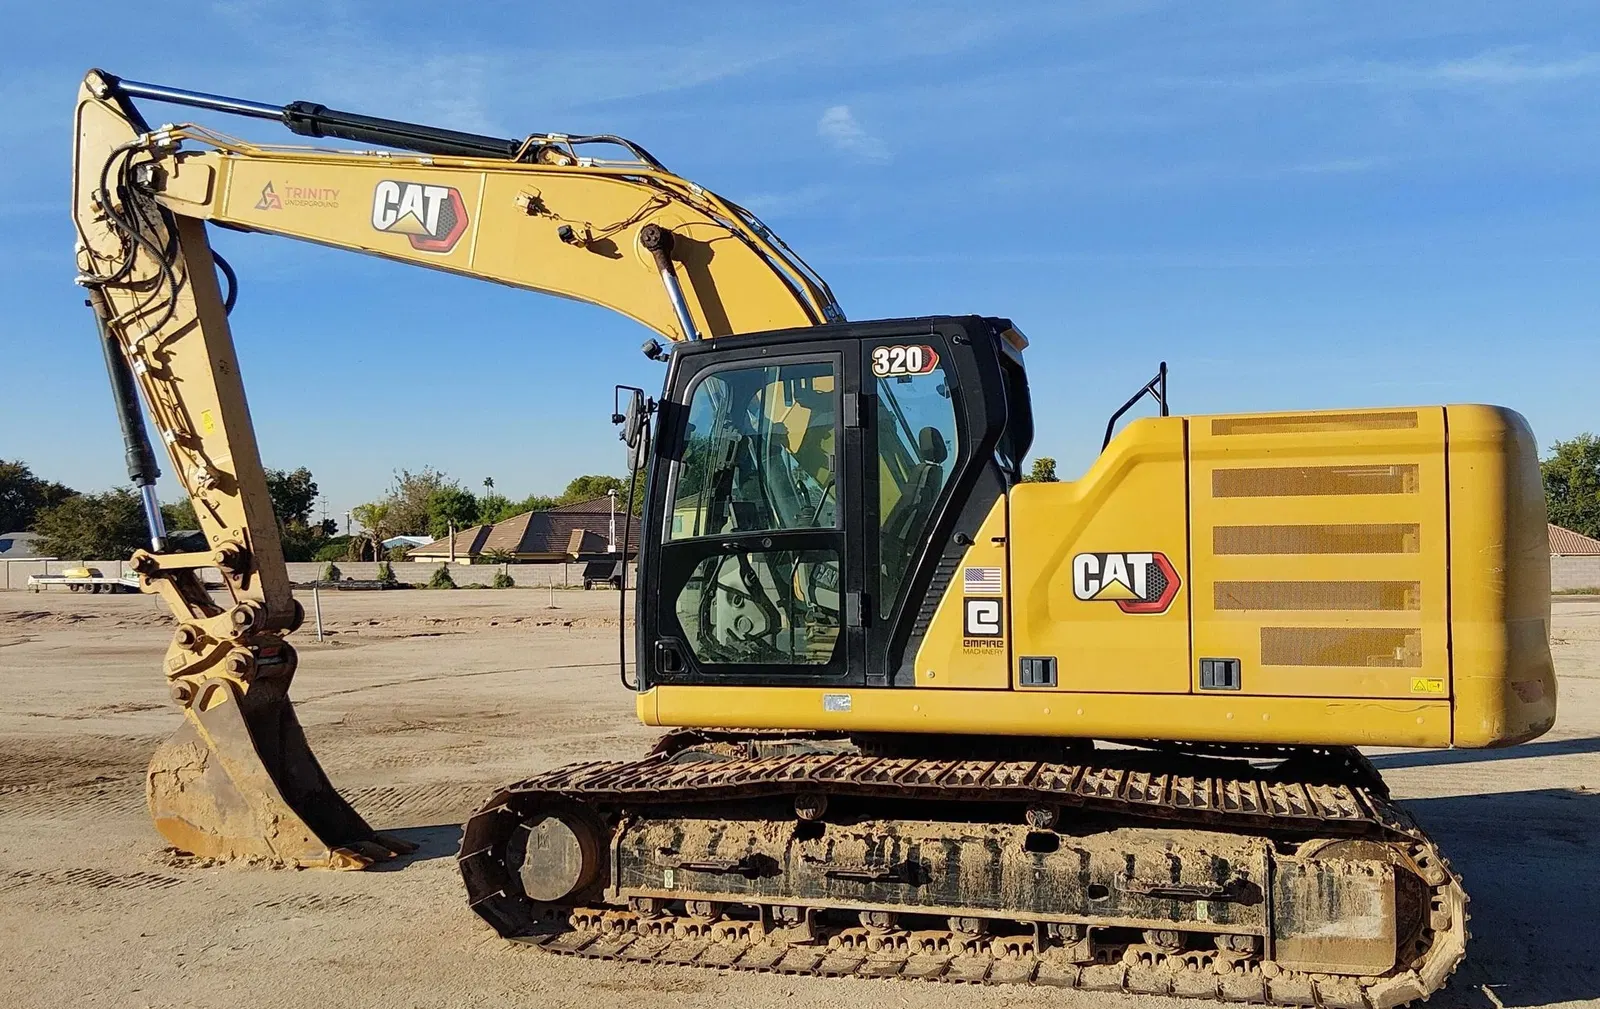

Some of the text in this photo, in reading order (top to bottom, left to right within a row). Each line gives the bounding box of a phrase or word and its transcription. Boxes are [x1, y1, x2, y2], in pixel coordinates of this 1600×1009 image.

[284, 199, 340, 208] UNDERGROUND
[285, 187, 340, 200] TRINITY
[372, 180, 449, 236] CAT
[874, 346, 922, 374] 320
[1073, 553, 1153, 600] CAT
